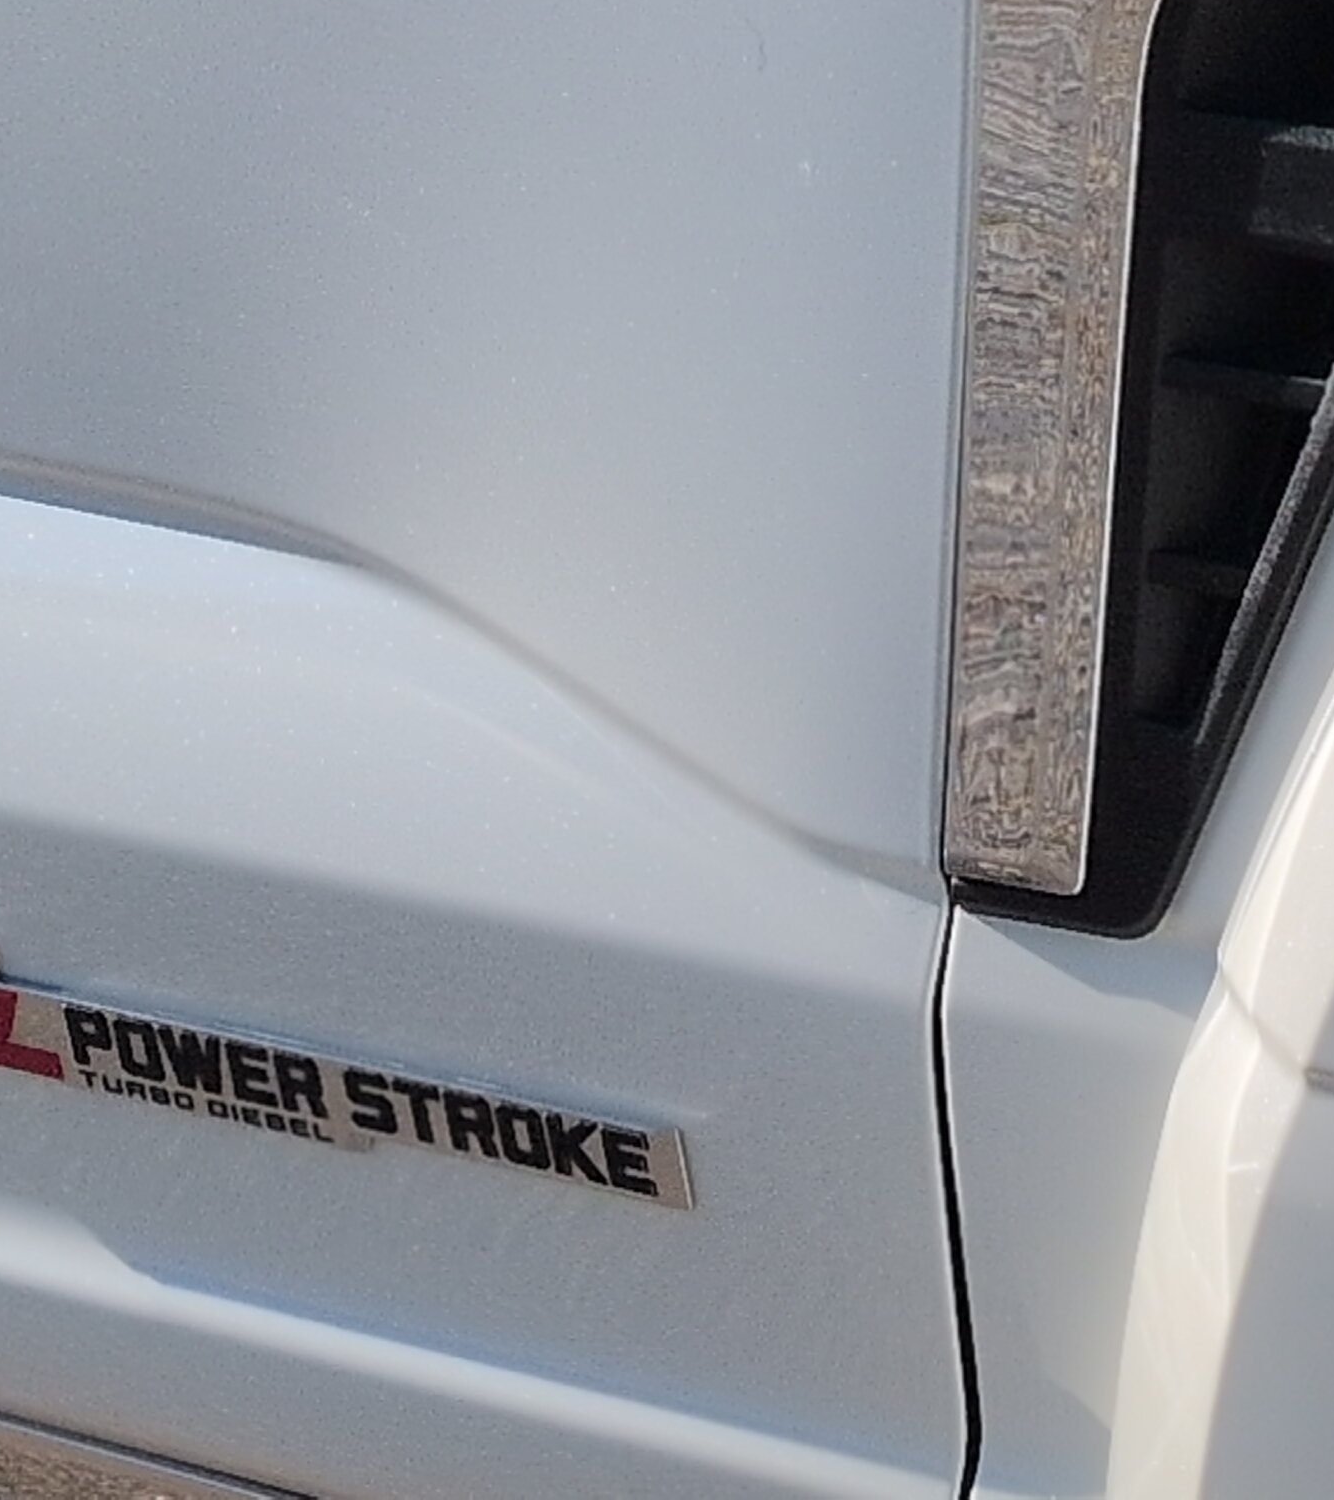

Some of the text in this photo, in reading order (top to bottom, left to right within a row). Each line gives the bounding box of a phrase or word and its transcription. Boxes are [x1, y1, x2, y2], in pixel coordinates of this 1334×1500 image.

[64, 1006, 328, 1119] POWER
[343, 1067, 660, 1198] STROKE
[77, 1068, 335, 1143] TURBO DIESEL
